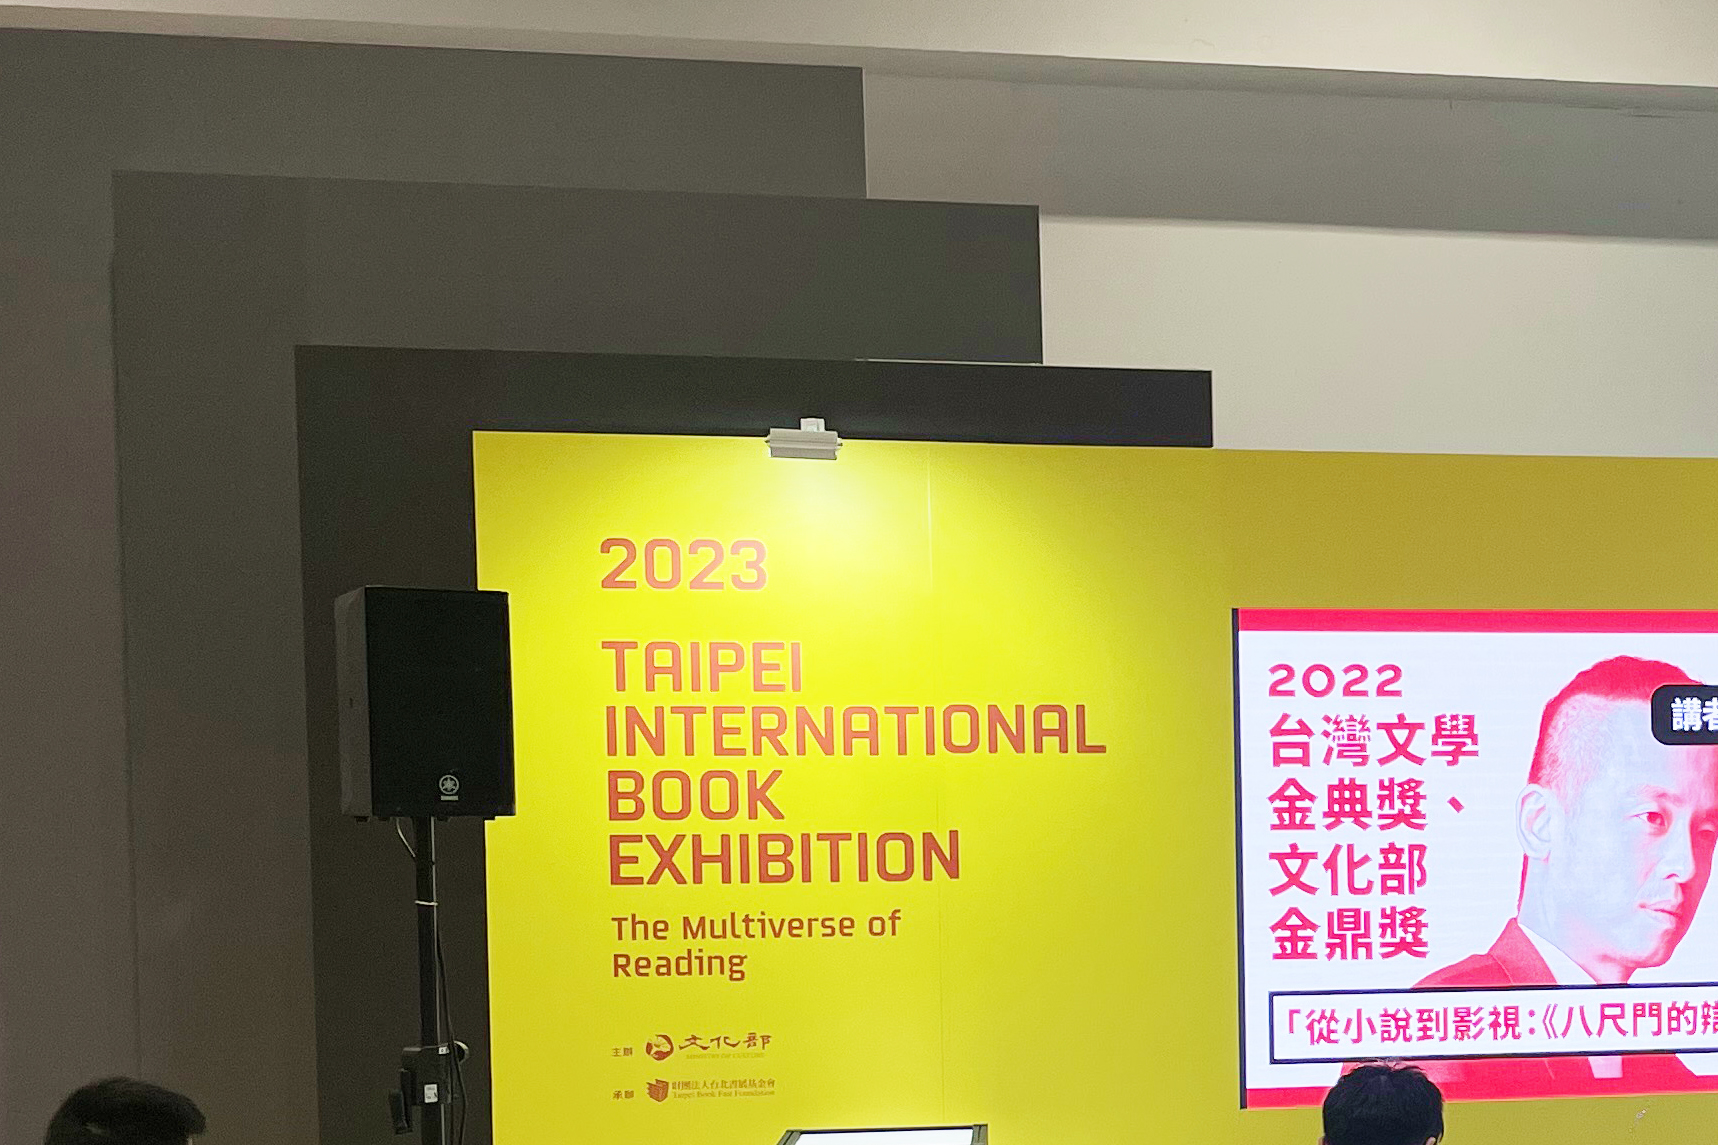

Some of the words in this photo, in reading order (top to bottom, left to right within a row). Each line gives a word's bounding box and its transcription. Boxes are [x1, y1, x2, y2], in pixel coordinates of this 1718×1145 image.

[600, 538, 768, 591] 2023
[601, 640, 802, 693] TAIPEI
[1268, 663, 1403, 698] 2022
[605, 704, 1107, 757] INTERNATIONAL
[1268, 712, 1479, 768] 台灣文學
[606, 769, 785, 822] BOOK
[1267, 776, 1466, 832] 金典獎、
[608, 829, 961, 886] EXHIBITION
[1268, 842, 1428, 897] 文化部
[611, 913, 670, 942] The
[681, 909, 856, 941] Multiverse
[867, 908, 902, 938] of
[1269, 905, 1430, 961] 金鼎獎
[612, 950, 749, 982] Reading
[678, 1032, 772, 1051] 文化部
